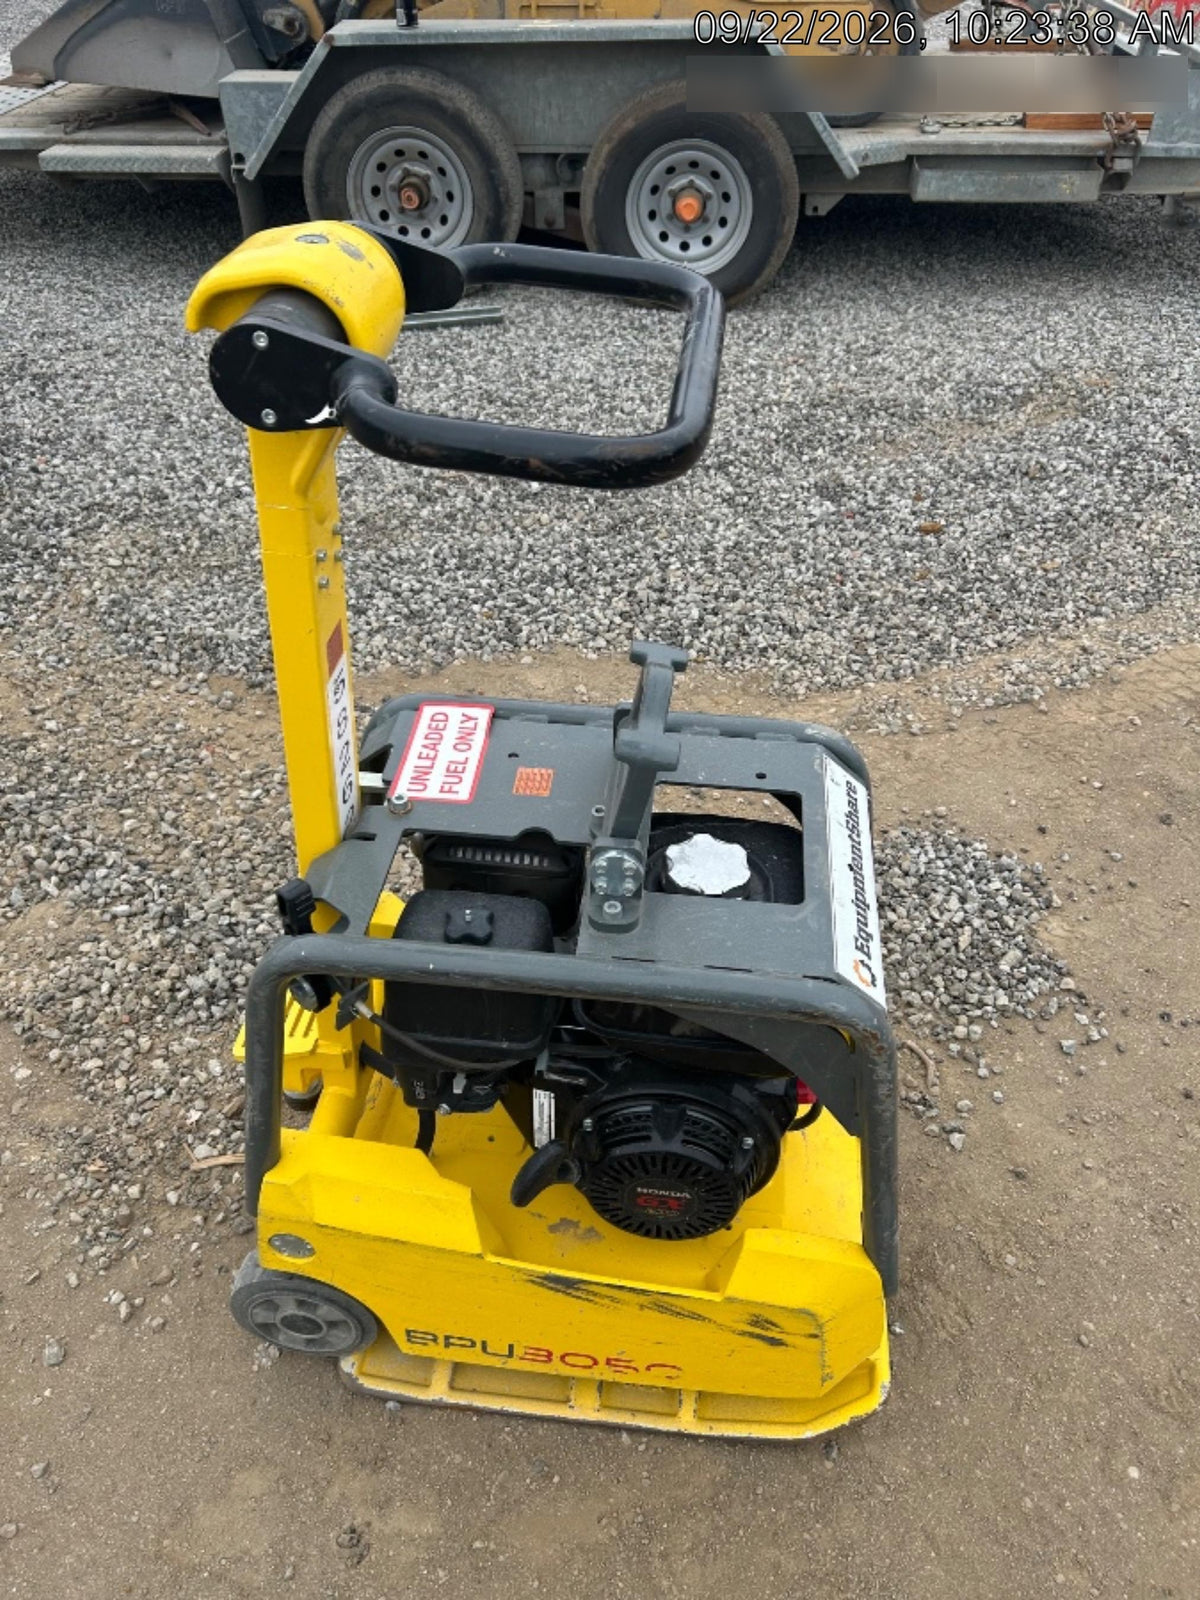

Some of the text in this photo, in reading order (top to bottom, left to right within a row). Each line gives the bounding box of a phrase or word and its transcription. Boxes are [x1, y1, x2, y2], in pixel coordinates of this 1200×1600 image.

[406, 711, 449, 792] UNLEADED
[438, 711, 480, 795] FUEL ONLY
[845, 779, 873, 961] EquipmentShare
[637, 1187, 693, 1199] HONDA
